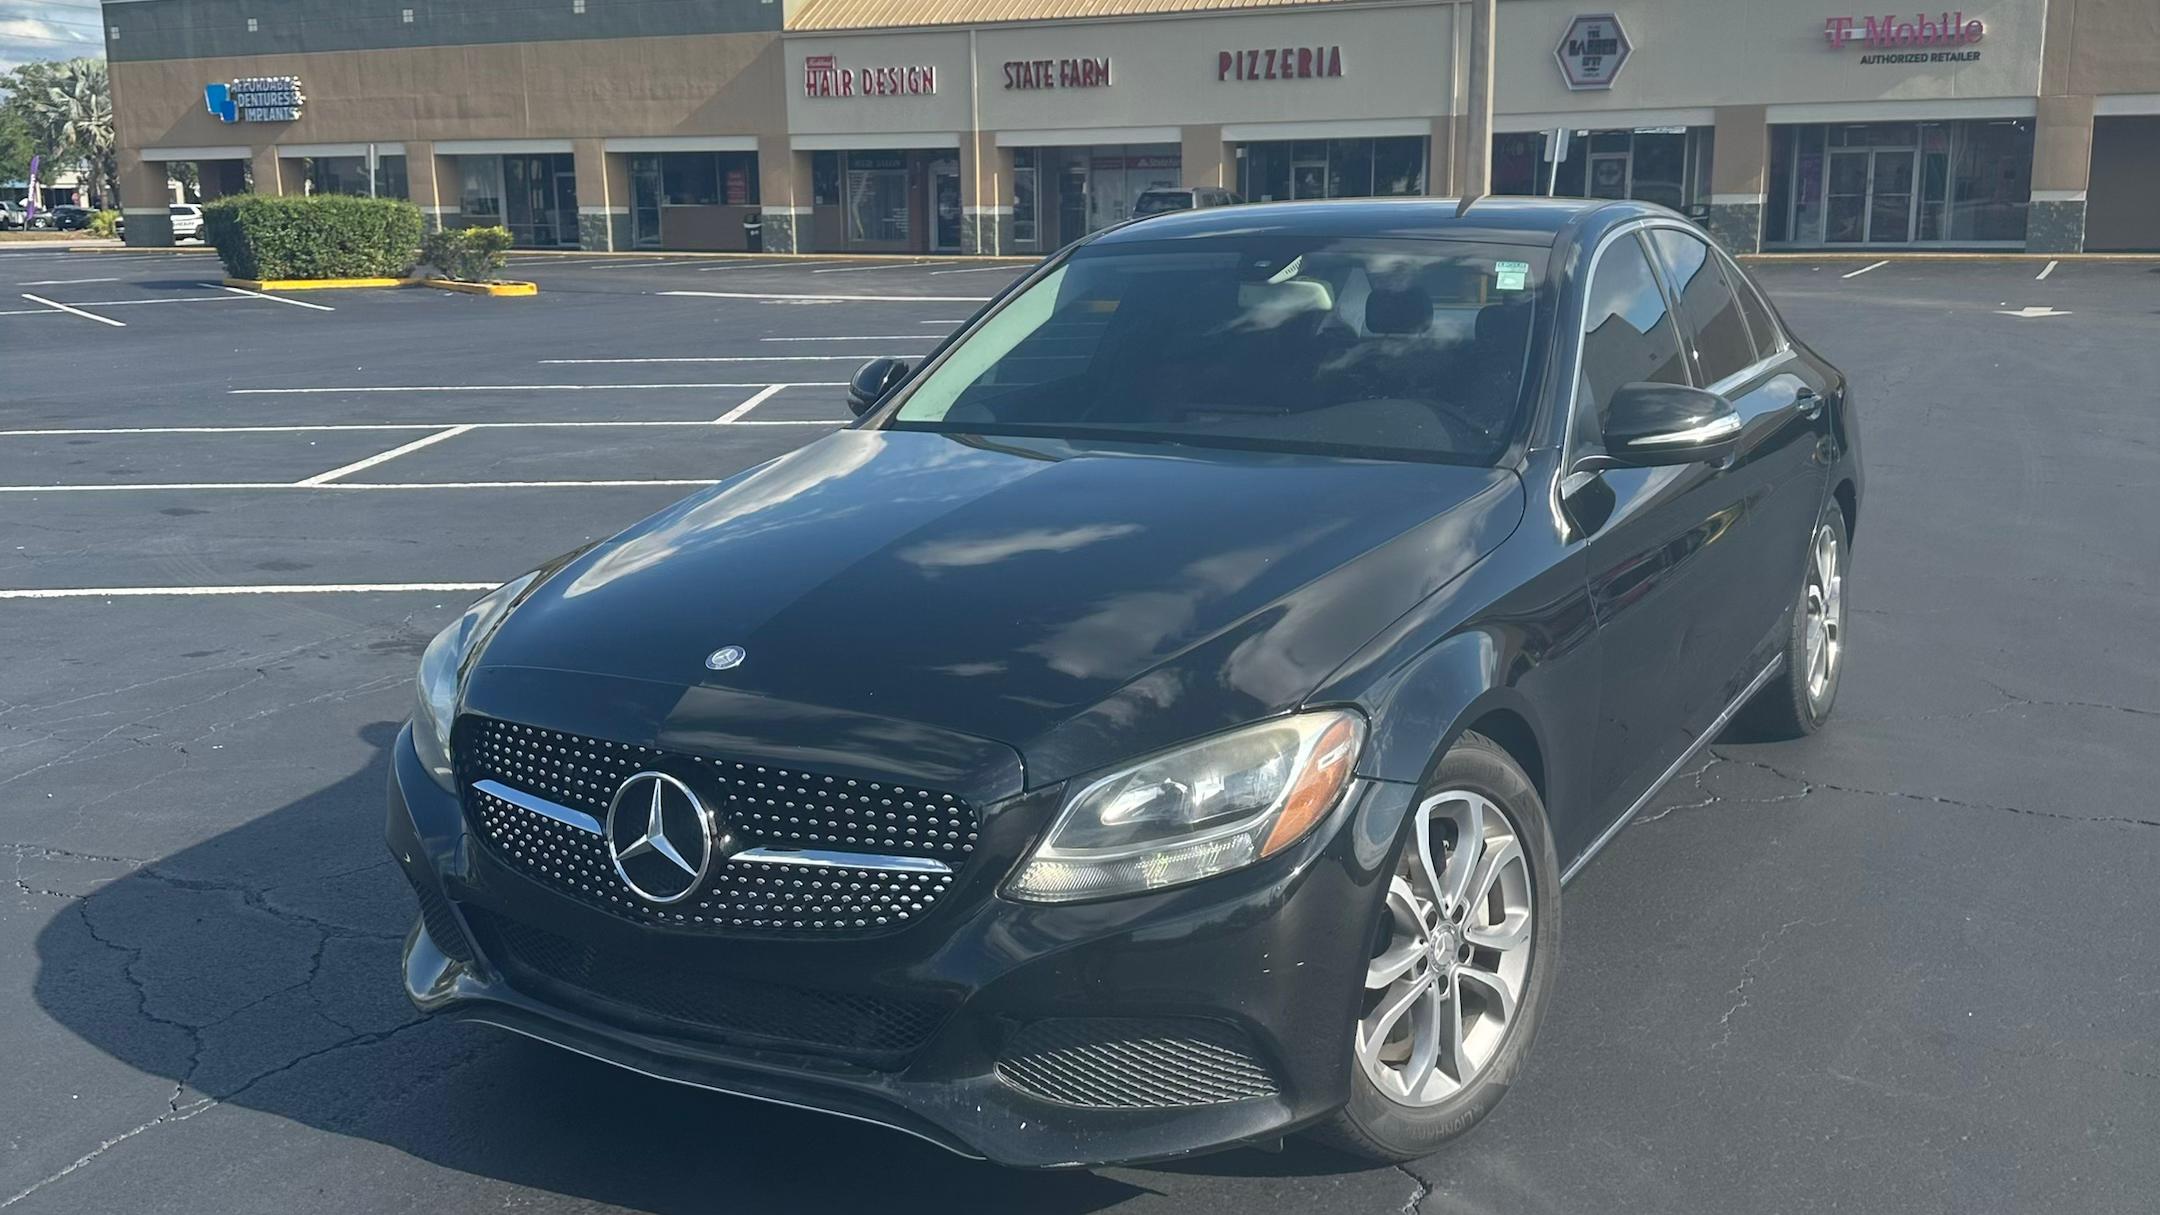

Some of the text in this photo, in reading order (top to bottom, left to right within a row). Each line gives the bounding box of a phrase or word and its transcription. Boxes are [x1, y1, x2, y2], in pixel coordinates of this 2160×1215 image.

[1218, 46, 1344, 81] PIZZERIA
[1860, 51, 1981, 65] AUTHORIZED RETAILER
[805, 66, 936, 96] HAIR DESIGN
[1003, 58, 1112, 89] STATE FARM
[237, 92, 290, 107] DENTURES
[245, 107, 301, 121] IMPLANTS
